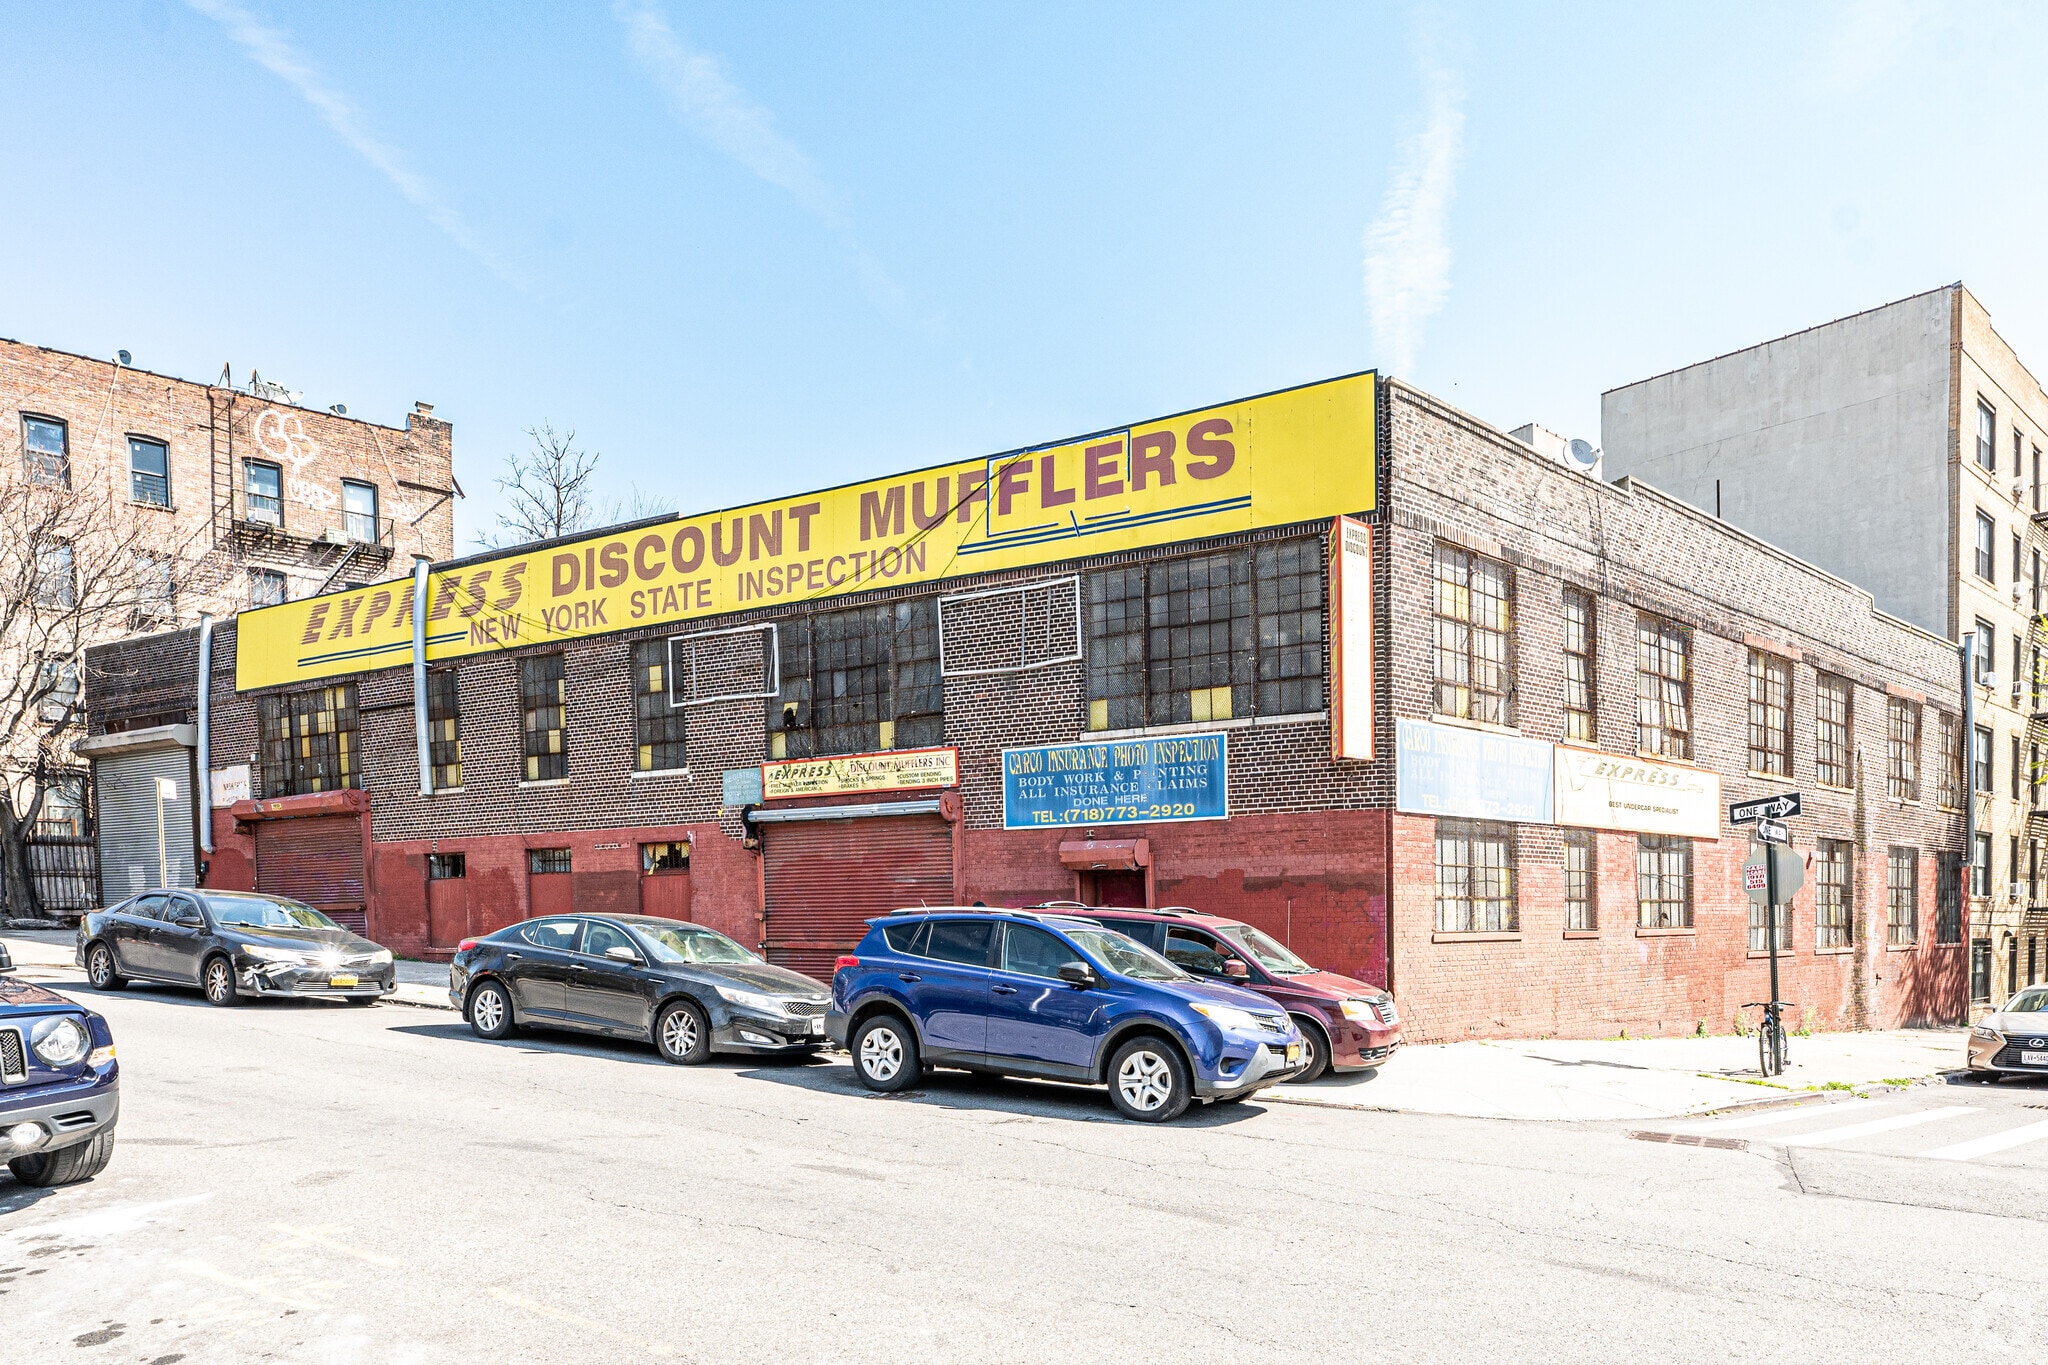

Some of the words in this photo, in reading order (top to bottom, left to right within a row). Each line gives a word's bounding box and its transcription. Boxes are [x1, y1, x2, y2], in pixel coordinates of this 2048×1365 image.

[300, 562, 528, 645] EXPRESS
[552, 502, 820, 597] DISCOUNT
[860, 418, 1236, 541] MUFFLERS
[1346, 527, 1366, 544] EXPRESS
[1345, 540, 1368, 558] DISCOUNT
[470, 612, 521, 647] NEW
[541, 597, 609, 634] YORK
[630, 578, 712, 618] STATE
[738, 541, 926, 602] INSPECTION
[1009, 750, 1043, 775] CARCO
[1048, 746, 1109, 772] INSURANCE
[1114, 743, 1149, 767] PHOTO
[1153, 738, 1220, 765] INSPECTION
[774, 765, 832, 780] EXPRESS
[850, 761, 891, 773] DISCOUNT
[894, 757, 933, 769] MUFFLERS
[936, 756, 951, 766] INC
[899, 772, 919, 780] CUSTOM
[920, 770, 942, 778] BENDING
[1018, 775, 1055, 788] BODY
[1063, 771, 1105, 784] WORK
[1113, 770, 1125, 781] &
[1133, 764, 1208, 780] PNTING
[1594, 762, 1680, 787] EXPRESS
[1018, 787, 1047, 799] ALL
[1054, 781, 1139, 797] INSURANCE
[1073, 796, 1109, 807] DONE
[1115, 793, 1148, 804] HERE
[1608, 800, 1622, 809] BEST
[1624, 803, 1652, 812] UNDERCAR
[1653, 805, 1679, 815] SPECIALIST
[1739, 806, 1759, 818] ONE
[1768, 800, 1790, 813] WAY
[1032, 803, 1196, 824] TEL:(718)773-2920
